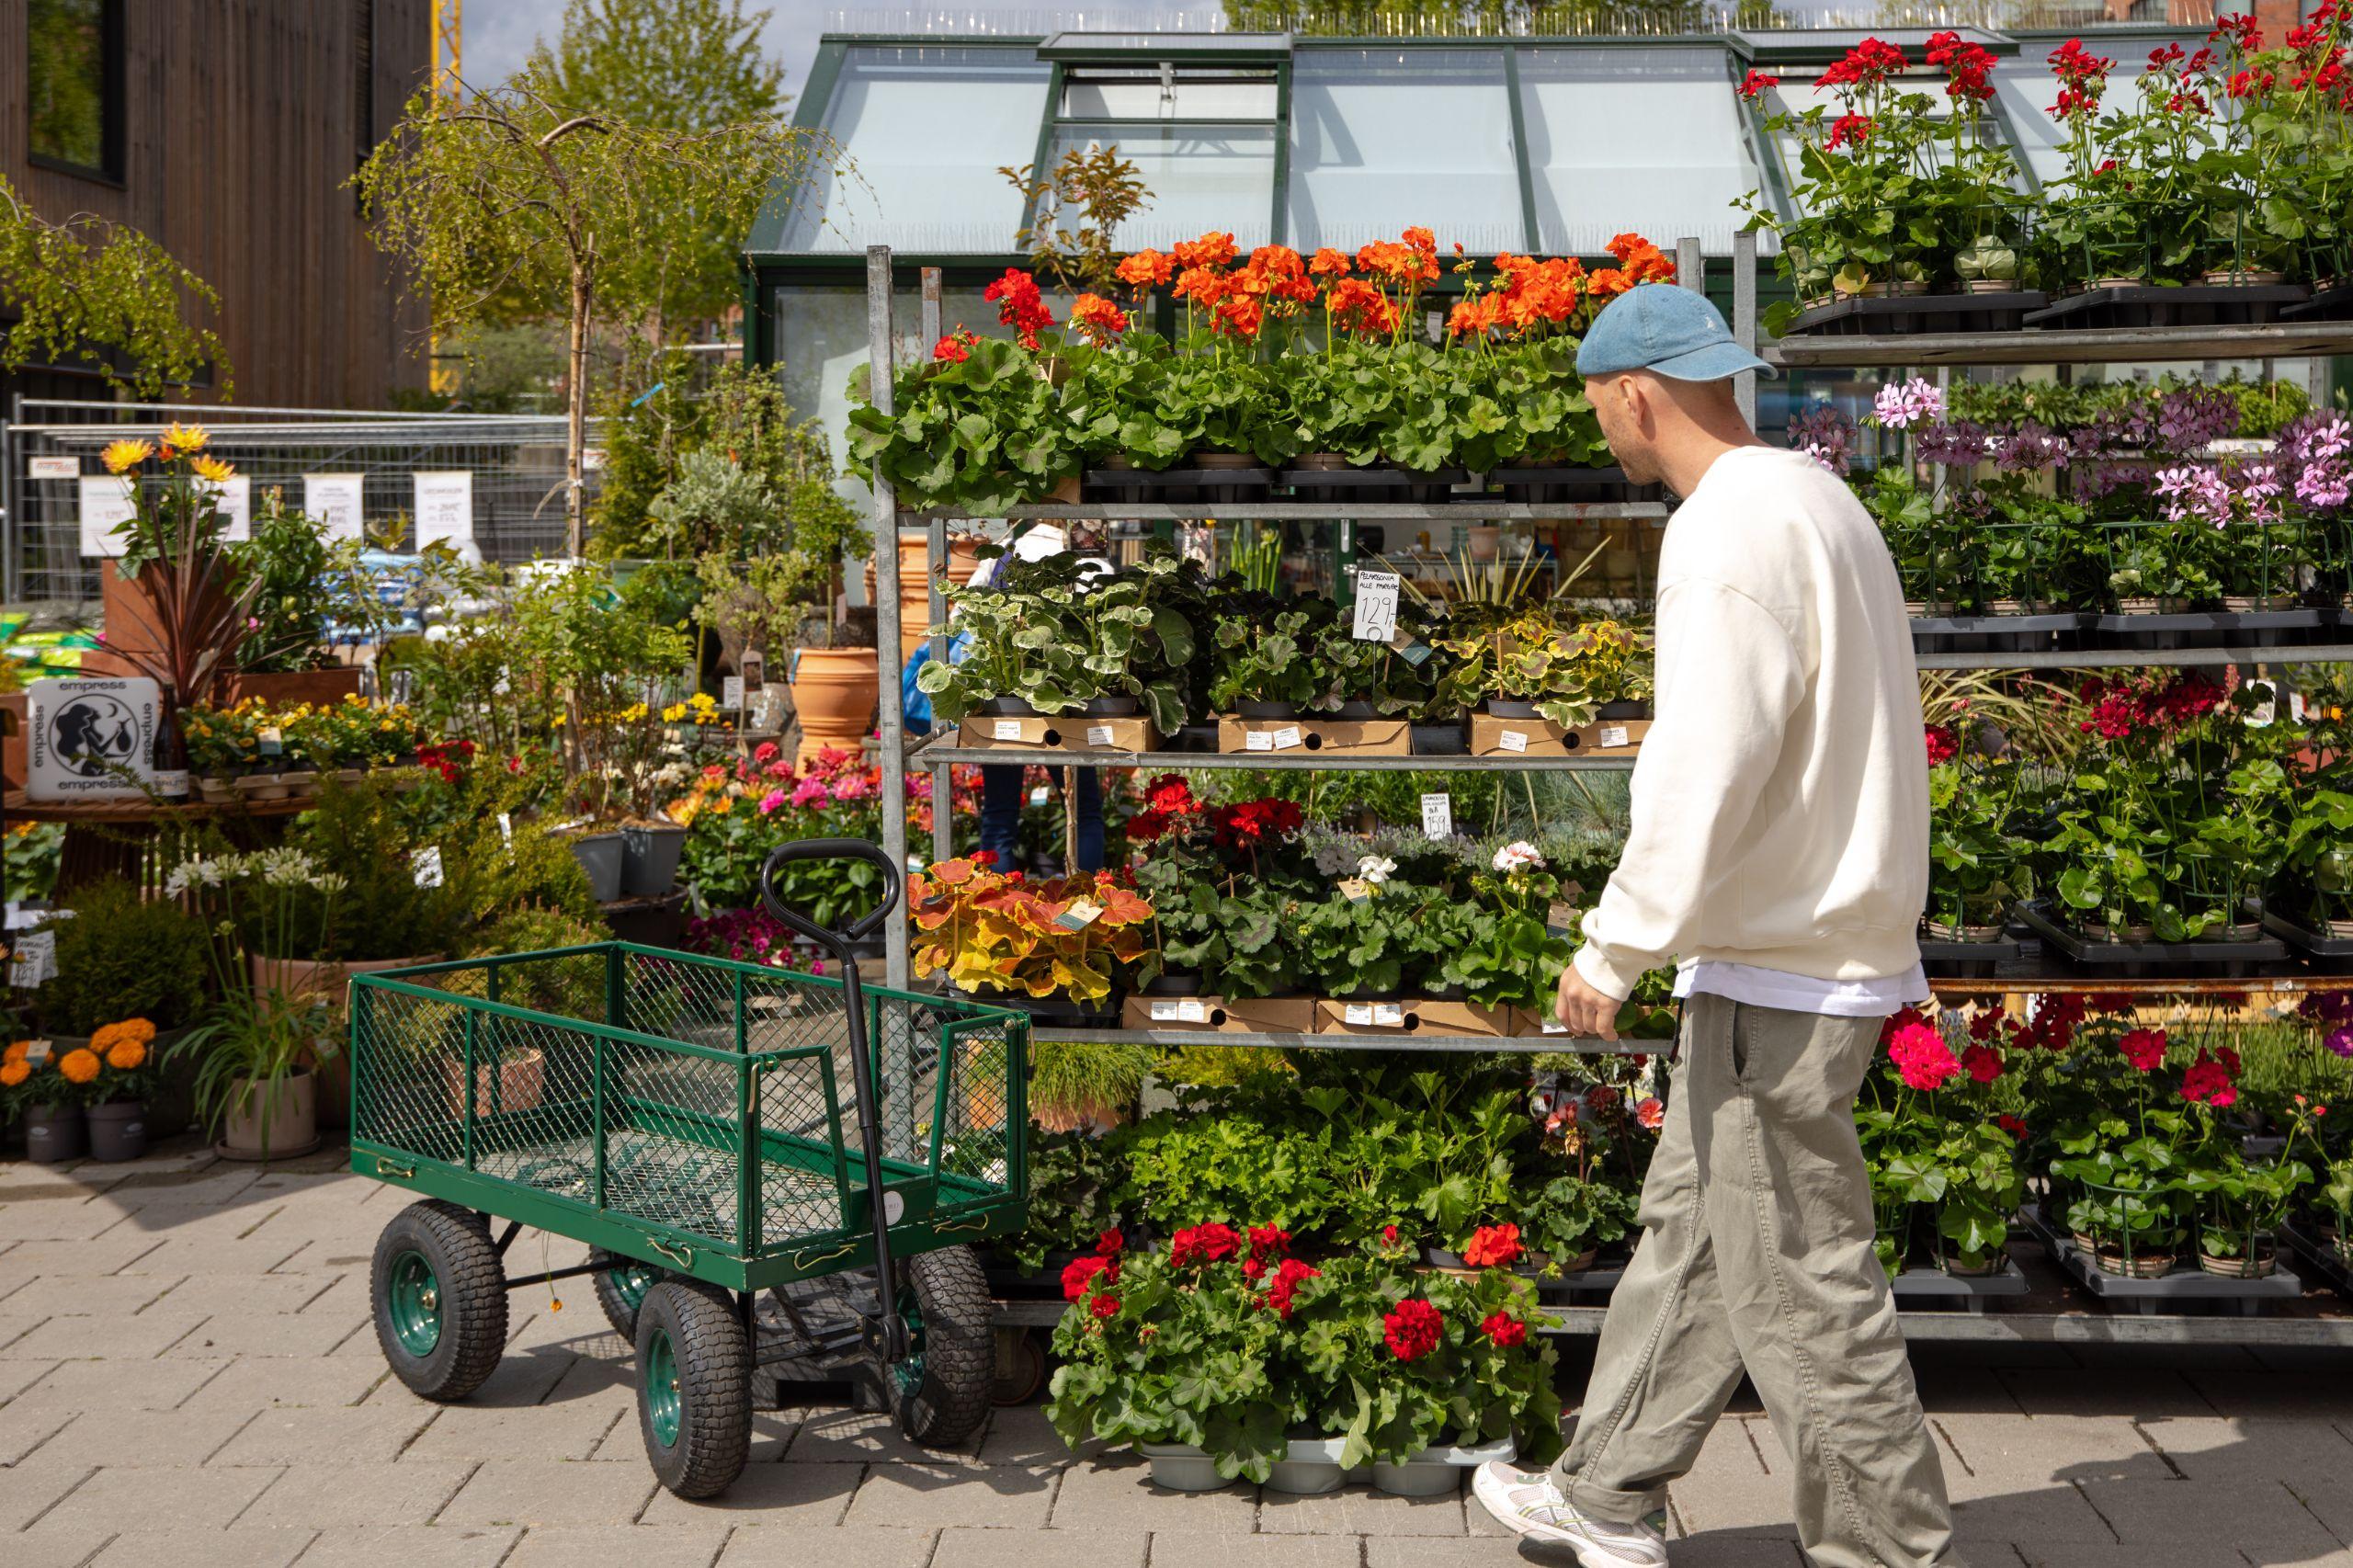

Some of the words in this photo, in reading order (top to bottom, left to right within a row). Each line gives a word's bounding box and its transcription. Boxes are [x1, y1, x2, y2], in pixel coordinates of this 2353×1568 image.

[59, 680, 127, 692] empress
[34, 705, 48, 768] empress
[141, 702, 153, 766] empress
